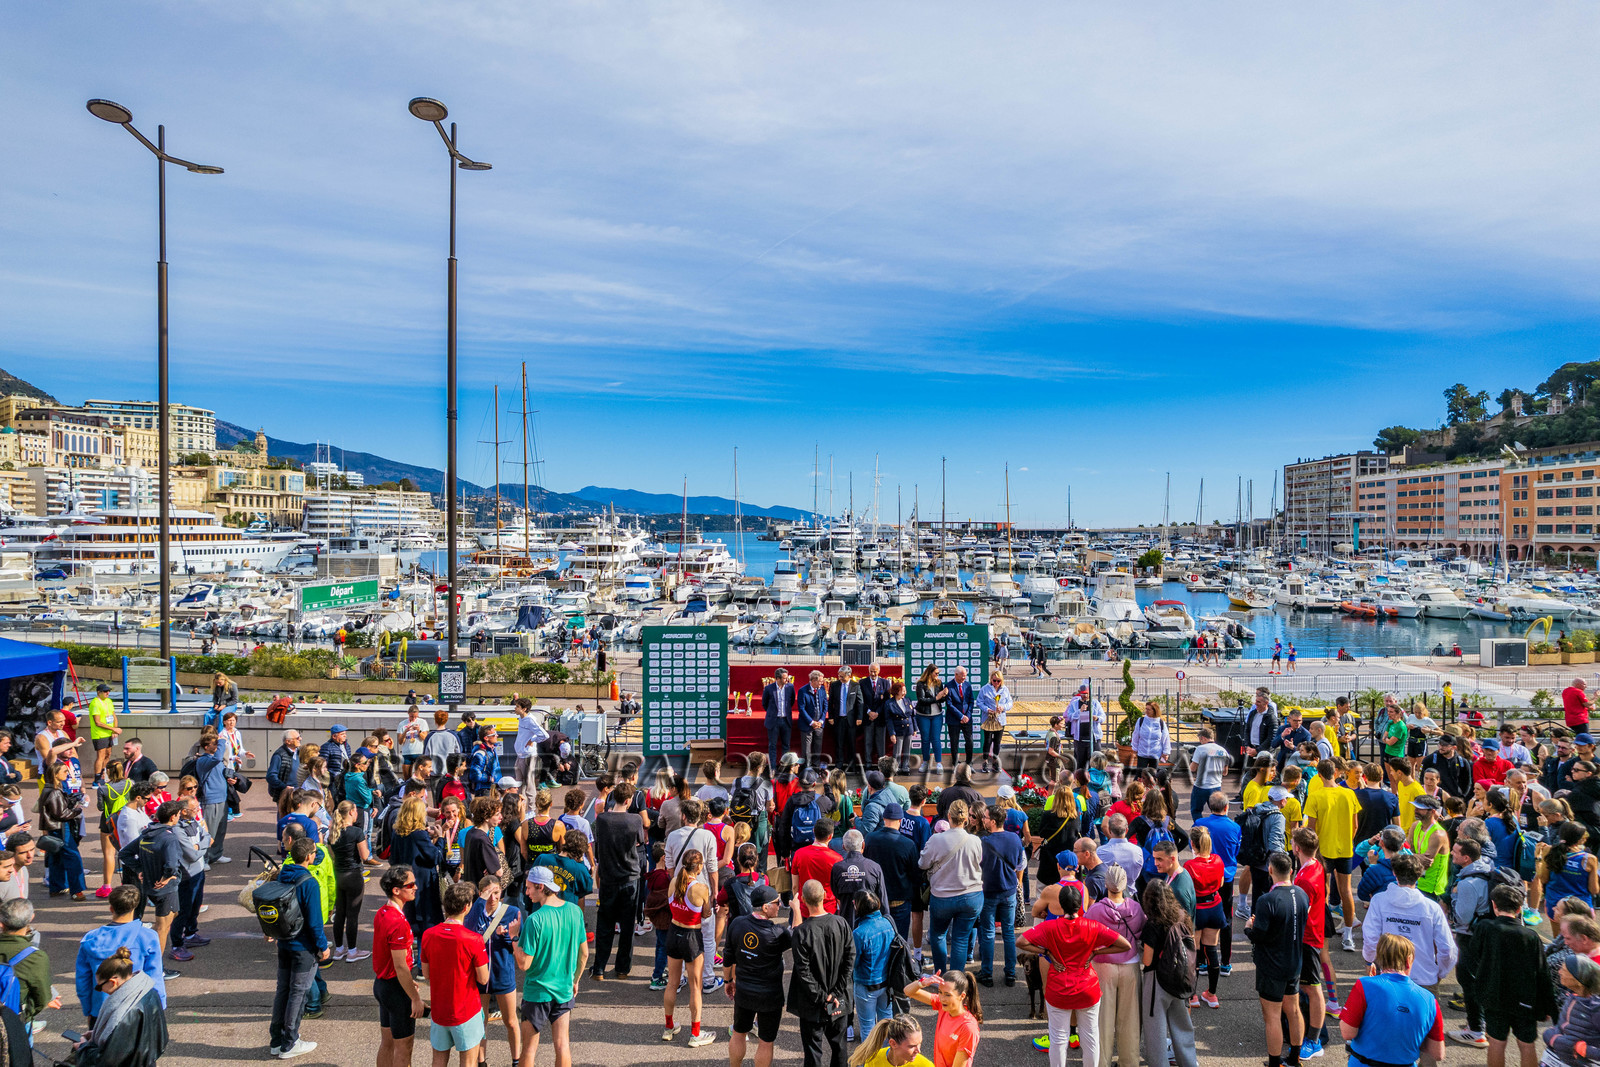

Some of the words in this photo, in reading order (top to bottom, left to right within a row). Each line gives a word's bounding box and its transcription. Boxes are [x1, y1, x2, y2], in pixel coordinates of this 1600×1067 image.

[330, 585, 354, 598] Départ
[900, 817, 915, 831] COS
[671, 902, 689, 912] MALTA
[1385, 917, 1422, 926] MONACORUN
